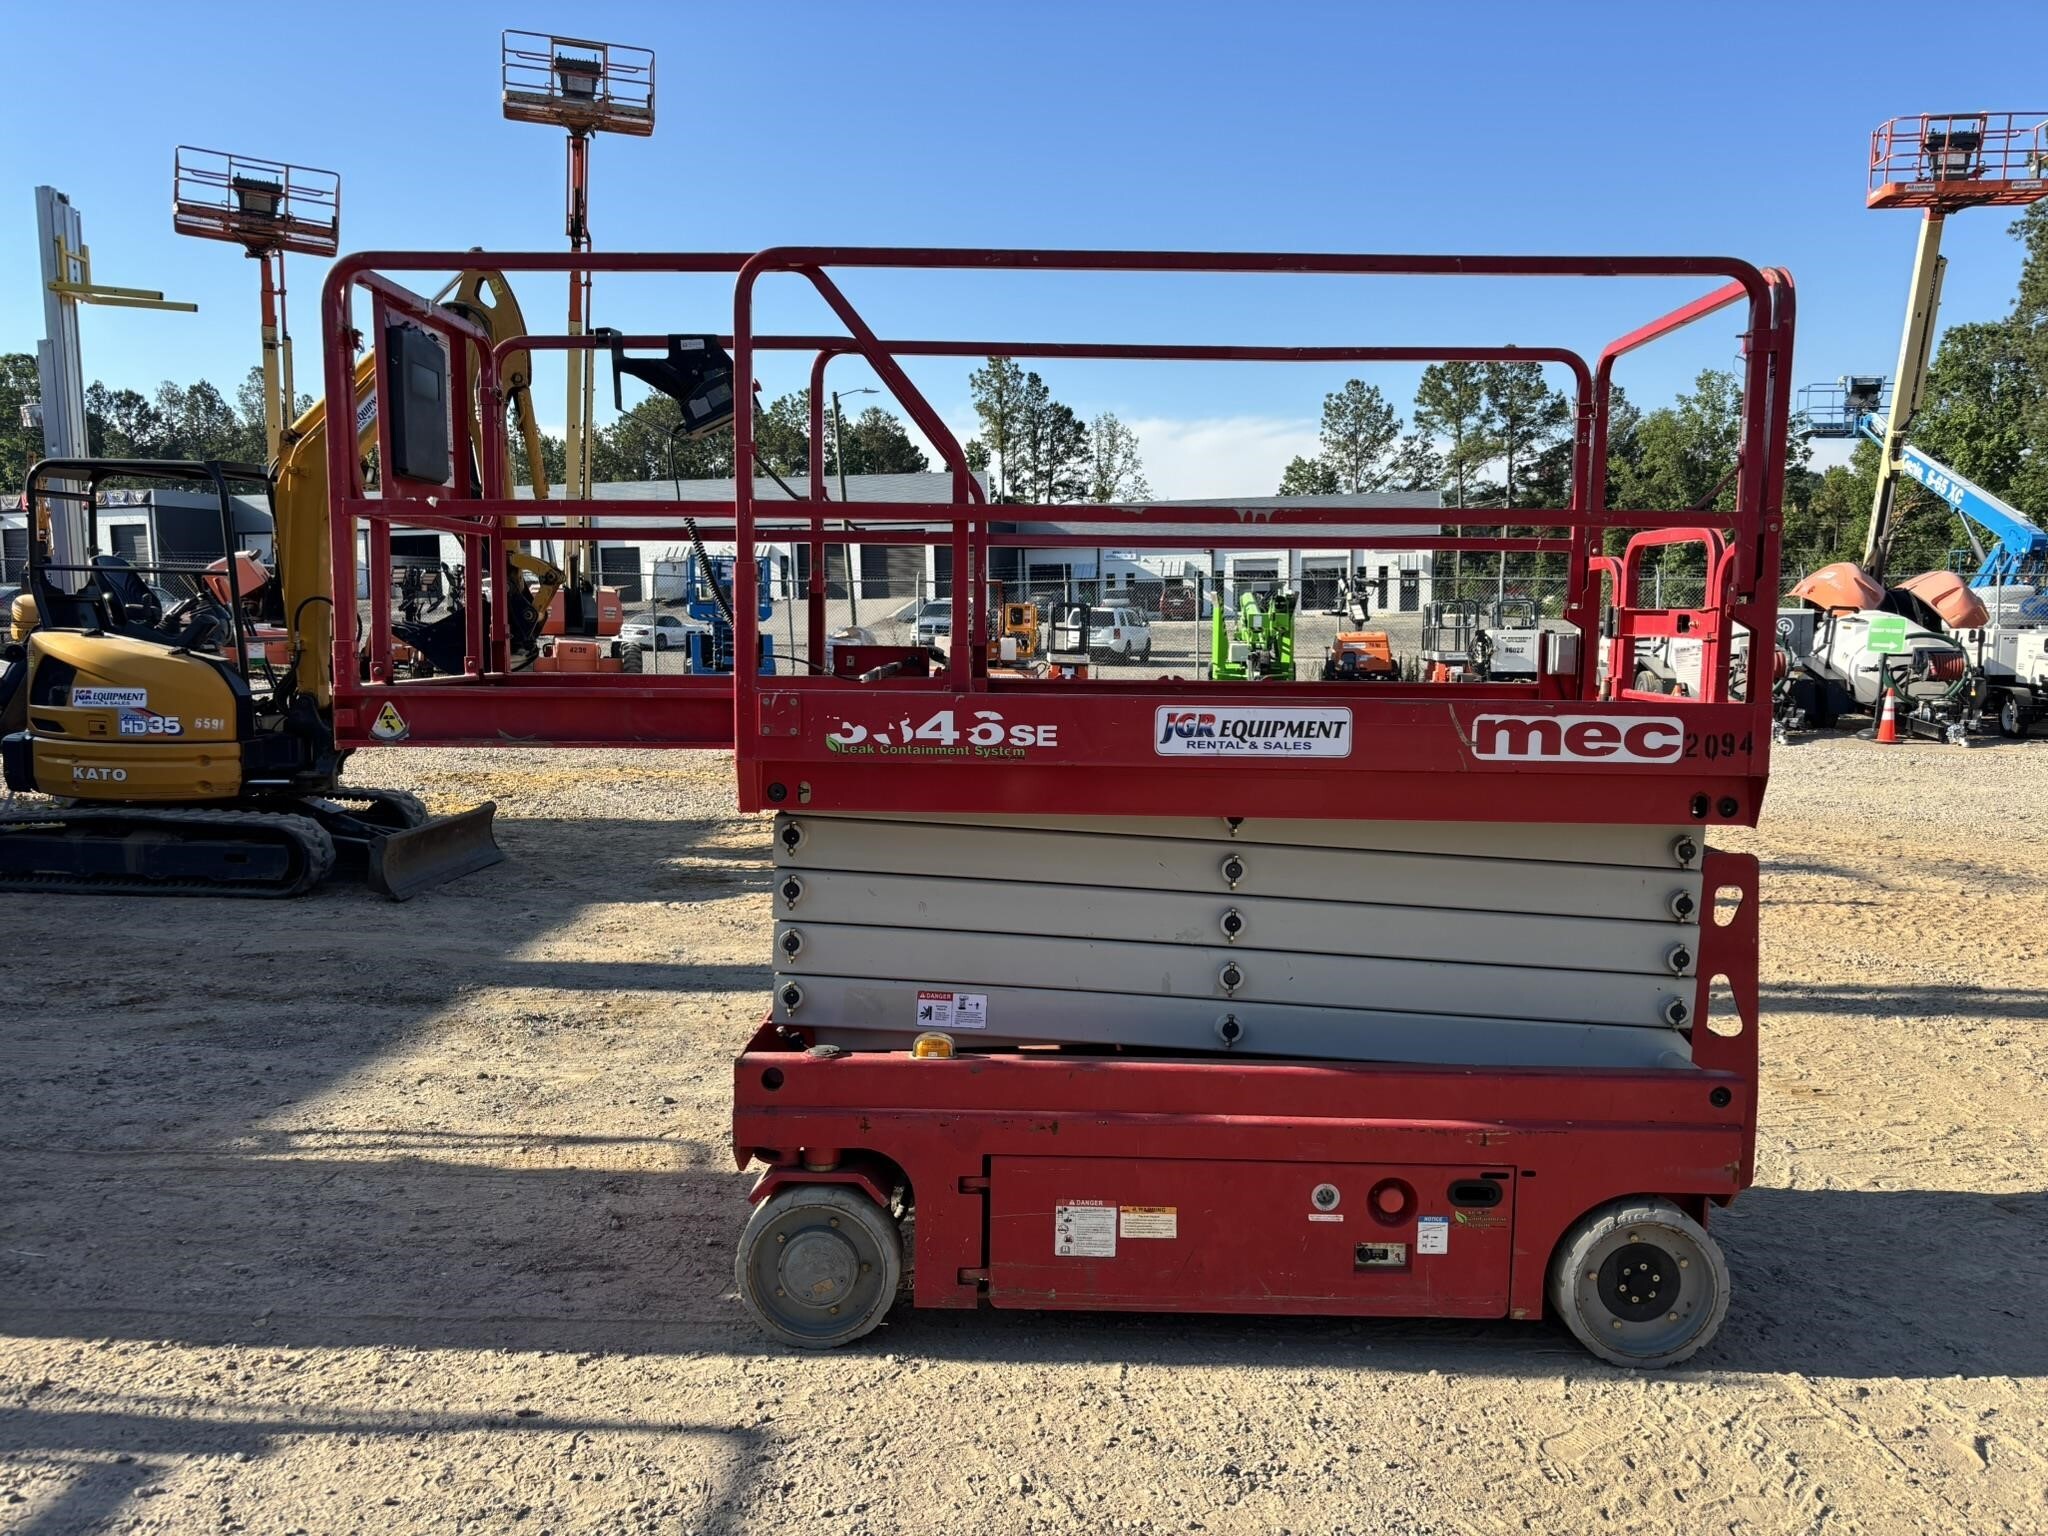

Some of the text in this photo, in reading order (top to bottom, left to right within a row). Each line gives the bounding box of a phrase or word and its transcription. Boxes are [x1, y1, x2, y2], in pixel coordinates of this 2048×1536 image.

[1946, 482, 1964, 505] XC
[73, 689, 145, 703] JGR EQUIPMENT
[121, 716, 180, 734] HD35
[1159, 712, 1347, 745] JGR EQUIPMENT
[1186, 740, 1313, 751] RENTAL & SALES
[1476, 718, 1682, 759] mec
[1685, 731, 1754, 761] 2094
[841, 743, 875, 755] Leak
[879, 744, 970, 756] Containment
[72, 767, 127, 782] KATO
